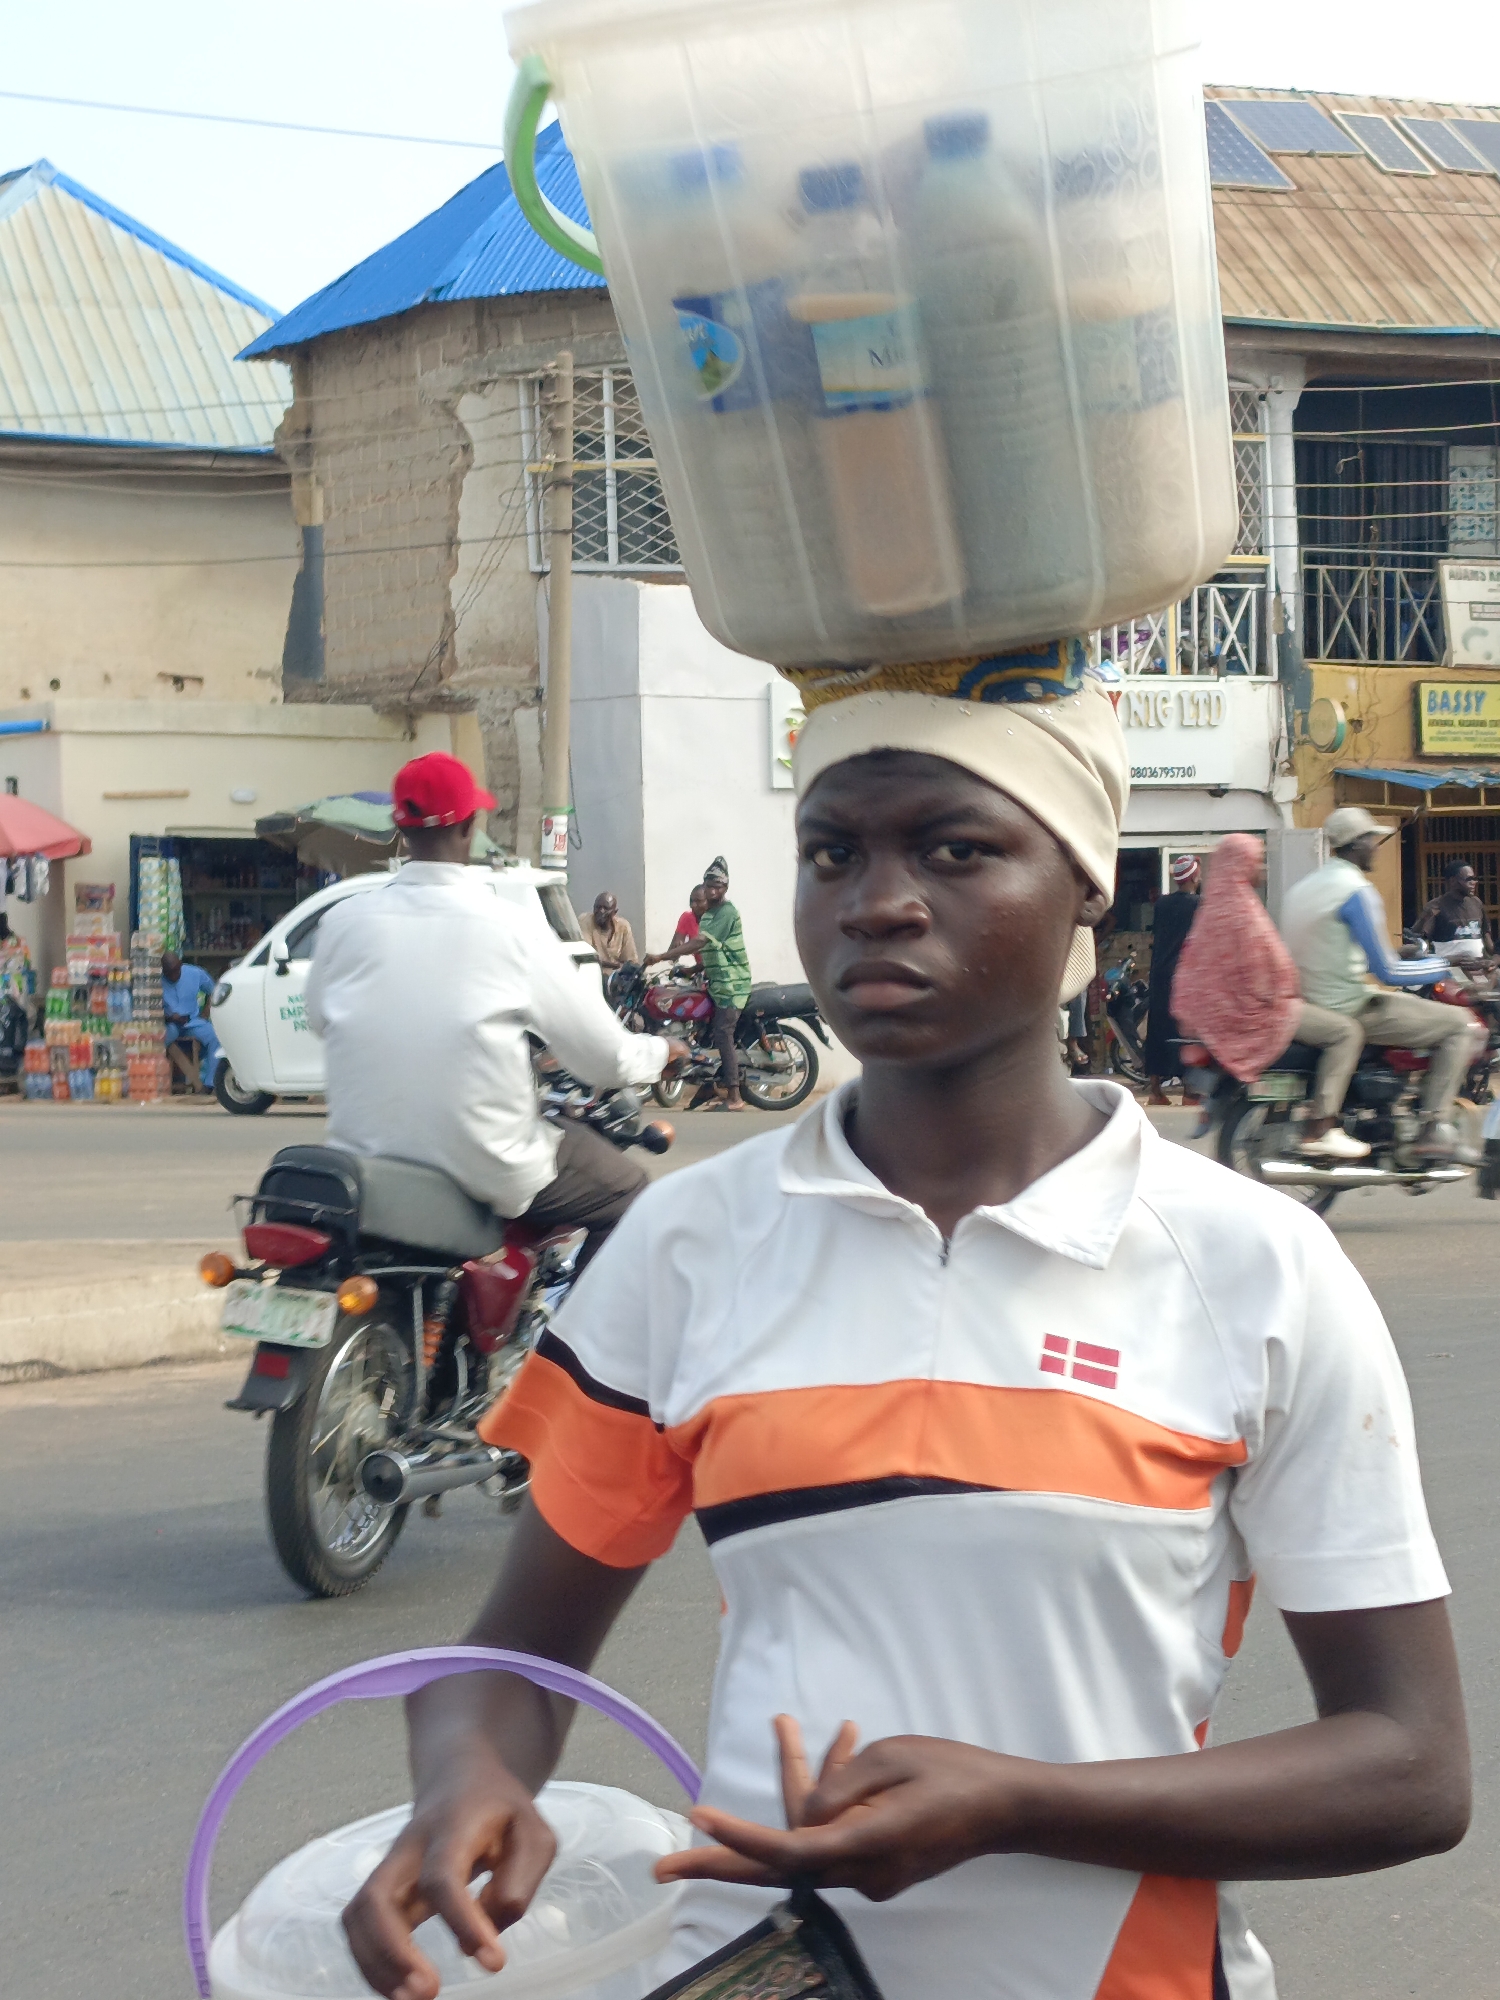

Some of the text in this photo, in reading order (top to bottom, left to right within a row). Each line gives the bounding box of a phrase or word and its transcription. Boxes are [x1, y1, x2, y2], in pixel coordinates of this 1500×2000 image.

[1126, 689, 1174, 728] NIG
[1179, 689, 1227, 728] LTD
[1427, 689, 1487, 715] BASSY
